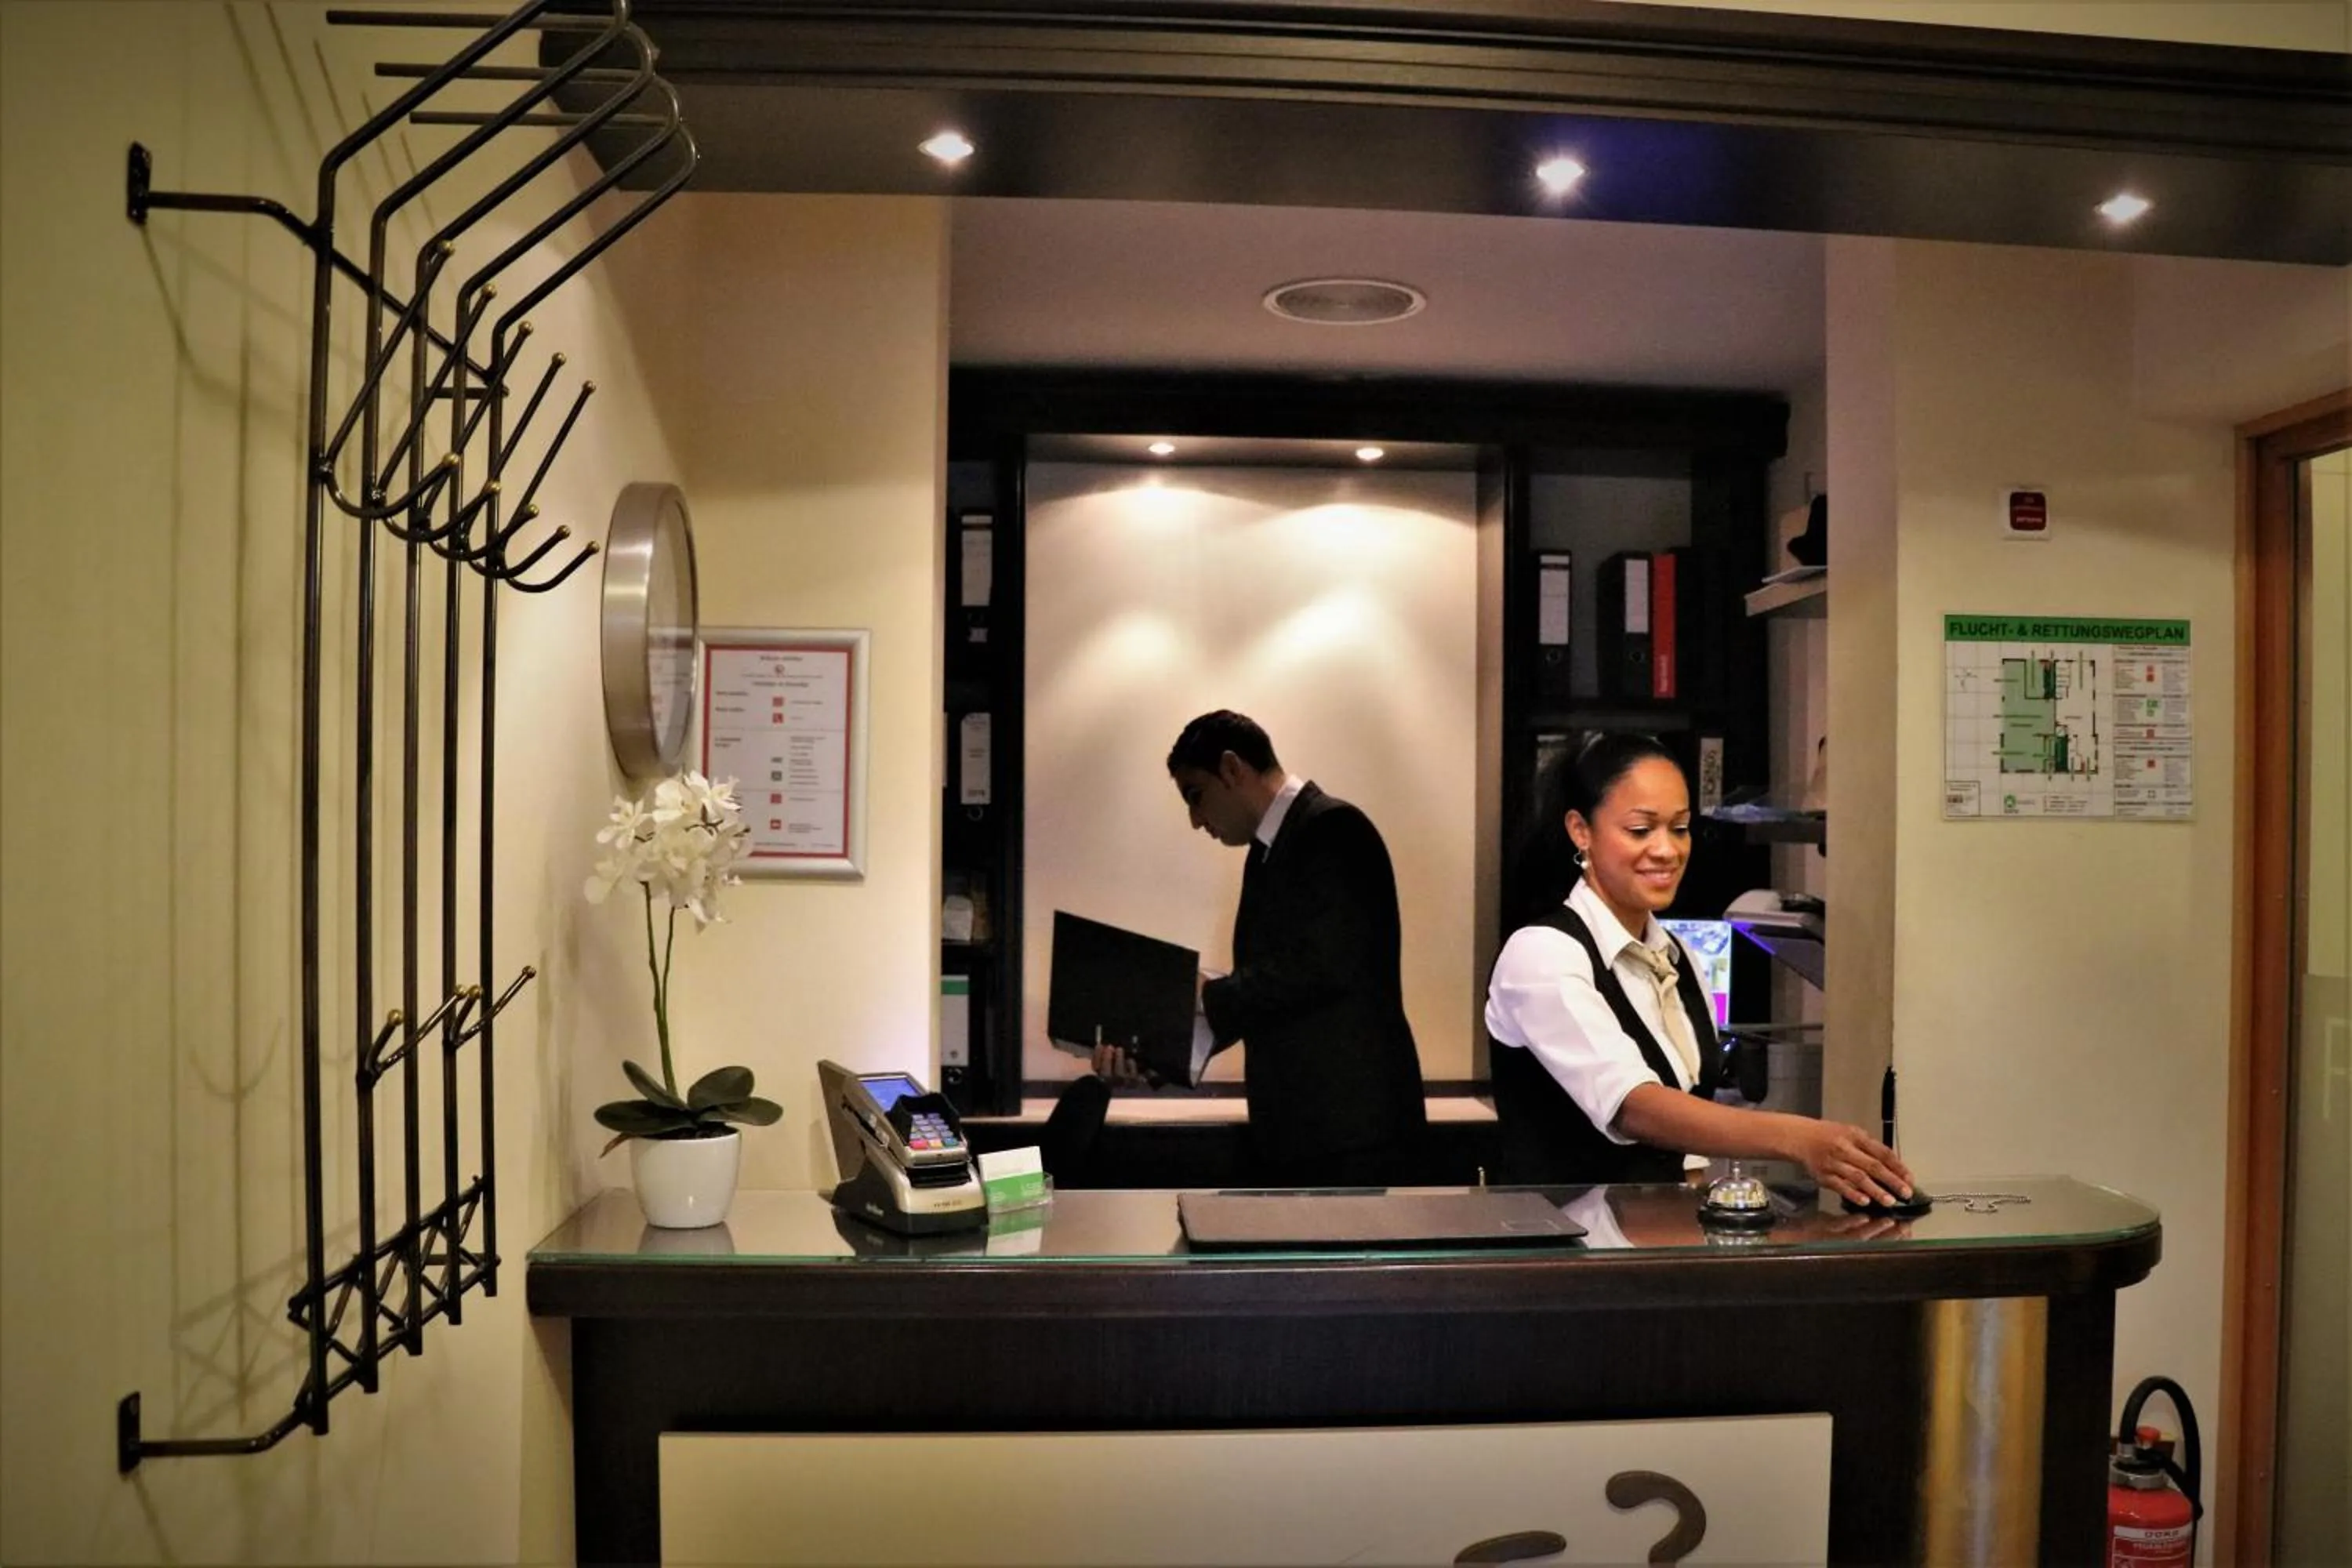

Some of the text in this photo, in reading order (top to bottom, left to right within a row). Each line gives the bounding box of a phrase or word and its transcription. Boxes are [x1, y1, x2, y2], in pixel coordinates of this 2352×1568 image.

[1950, 622, 2185, 641] FLUCHT- & RETTUNGSWEGPLAN
